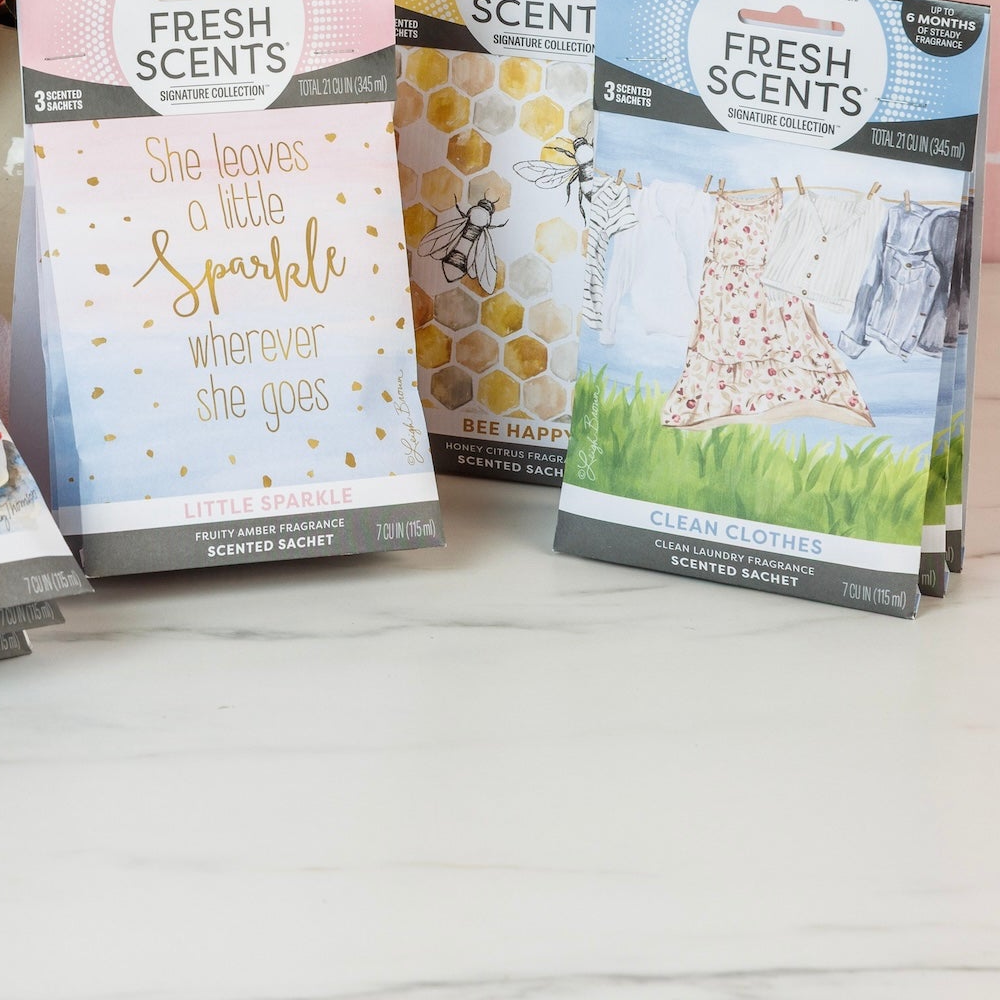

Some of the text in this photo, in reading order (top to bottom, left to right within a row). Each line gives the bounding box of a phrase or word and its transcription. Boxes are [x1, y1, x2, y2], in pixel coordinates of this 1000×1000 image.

[930, 6, 955, 16] UP TO
[150, 6, 272, 43] FRESH
[906, 12, 976, 32] 6 MONTHS
[917, 25, 961, 39] OF STEADY
[493, 34, 542, 49] SIGNATURE
[915, 35, 963, 50] FRAGRANCE
[724, 31, 852, 79] FRESH
[46, 90, 83, 101] SCENTED
[160, 89, 208, 102] SIGNATURE
[298, 76, 388, 97] TOTAL 21 CU IN (345 ml)
[604, 81, 615, 102] 3
[616, 83, 652, 98] SCENTED
[34, 91, 46, 112] 3
[47, 99, 83, 111] SACHETS
[615, 92, 652, 108] SACHETS
[727, 107, 777, 125] SIGNATURE
[871, 128, 965, 160] TOTAL 21 CU IN (345 ml)
[145, 133, 308, 183] She leaves
[188, 180, 285, 232] a little
[132, 216, 346, 317] Sparkle
[188, 320, 325, 369] wherever
[196, 374, 329, 433] she goes
[462, 418, 500, 436] BEE
[445, 441, 483, 454] HONEY
[485, 446, 525, 459] CITRUS
[457, 455, 521, 472] SCENTED
[184, 487, 353, 519] LITTLE SPARKLE
[195, 519, 345, 542] FRUITY AMBER FRAGRANCE
[649, 510, 823, 555] CLEAN CLOTHES
[207, 534, 335, 557] SCENTED SACHET
[654, 539, 815, 576] CLEAN LAUNDRY FRAGRANCE
[670, 555, 799, 588] SCENTED SACHET
[842, 581, 907, 609] 7 CU IN (115 ml)
